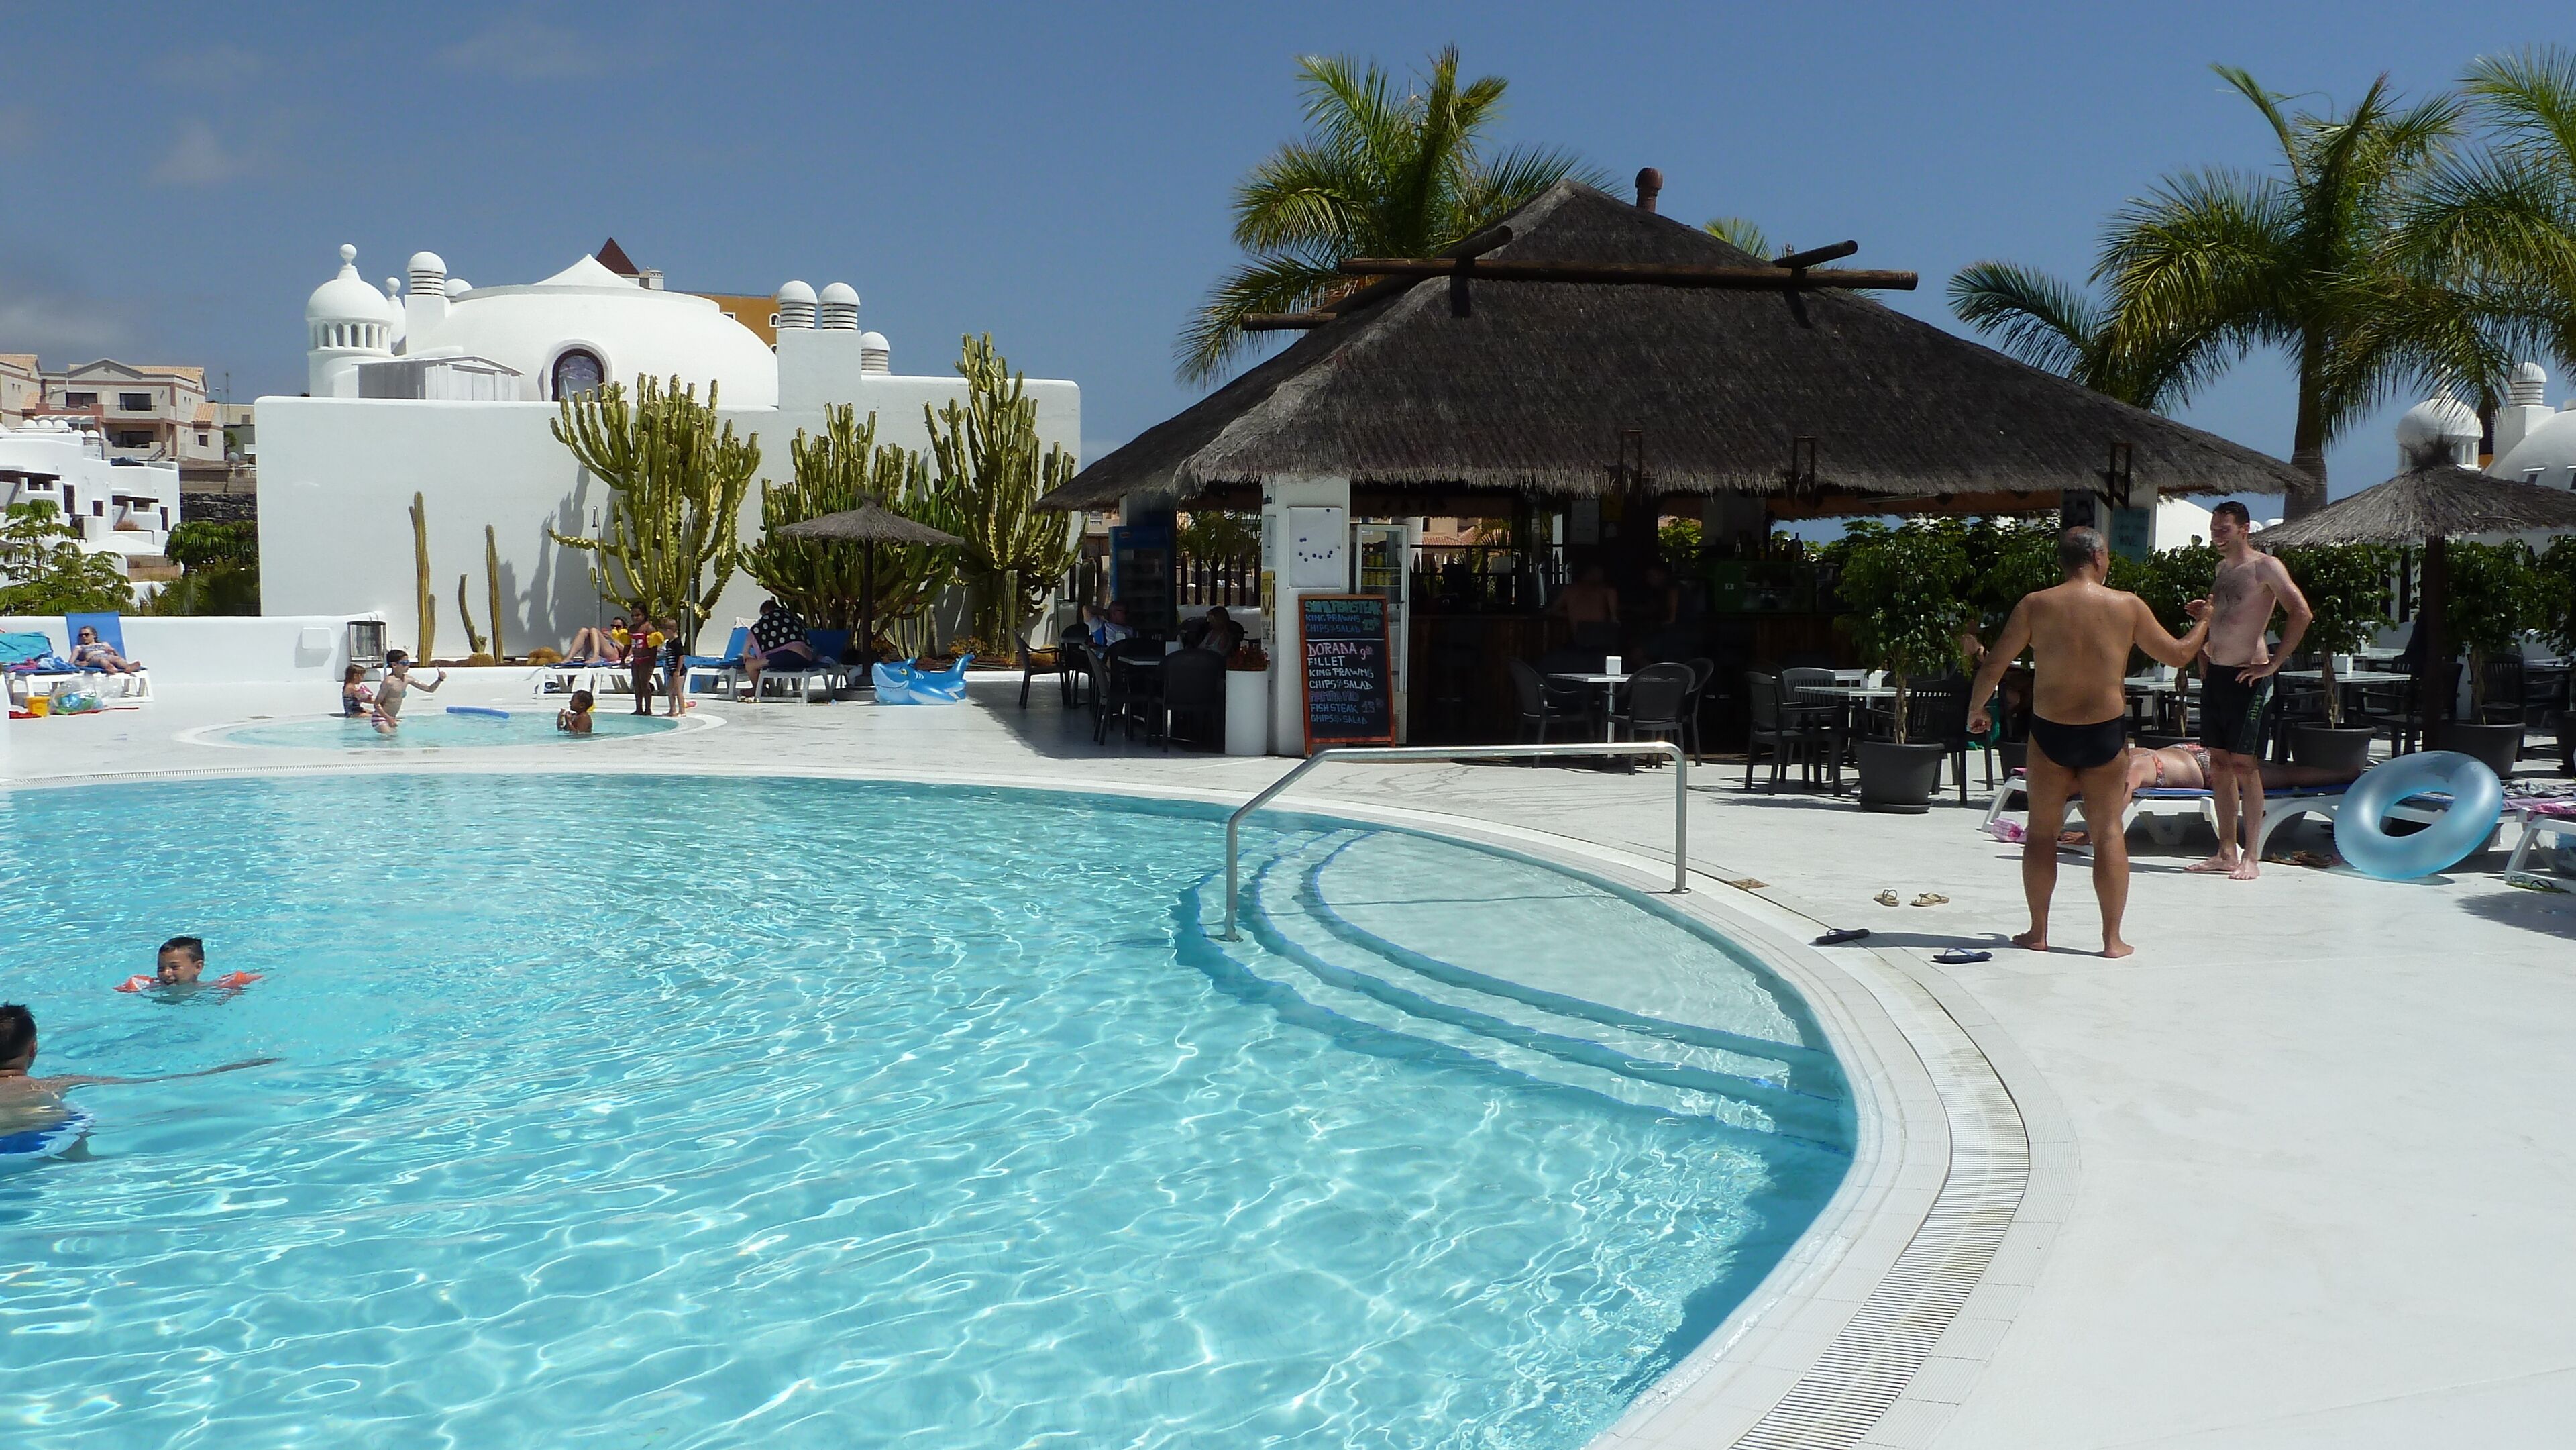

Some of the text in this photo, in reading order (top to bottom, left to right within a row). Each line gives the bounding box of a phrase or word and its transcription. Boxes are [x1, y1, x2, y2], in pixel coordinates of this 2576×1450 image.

[1305, 613, 1361, 623] KING PRAWNS
[1305, 624, 1329, 633] CHIPS
[1336, 624, 1362, 633] SALAD
[1307, 642, 1358, 656] DORADA
[1307, 655, 1346, 666] FILLET
[1309, 667, 1375, 679] KING PRAWNS
[1309, 679, 1336, 690] CHIPS
[1343, 679, 1373, 690] SALAD
[1310, 703, 1329, 713] FISH
[1330, 703, 1359, 714] STEAK
[1310, 714, 1334, 723] CHIPS
[1342, 715, 1368, 725] SALAD
